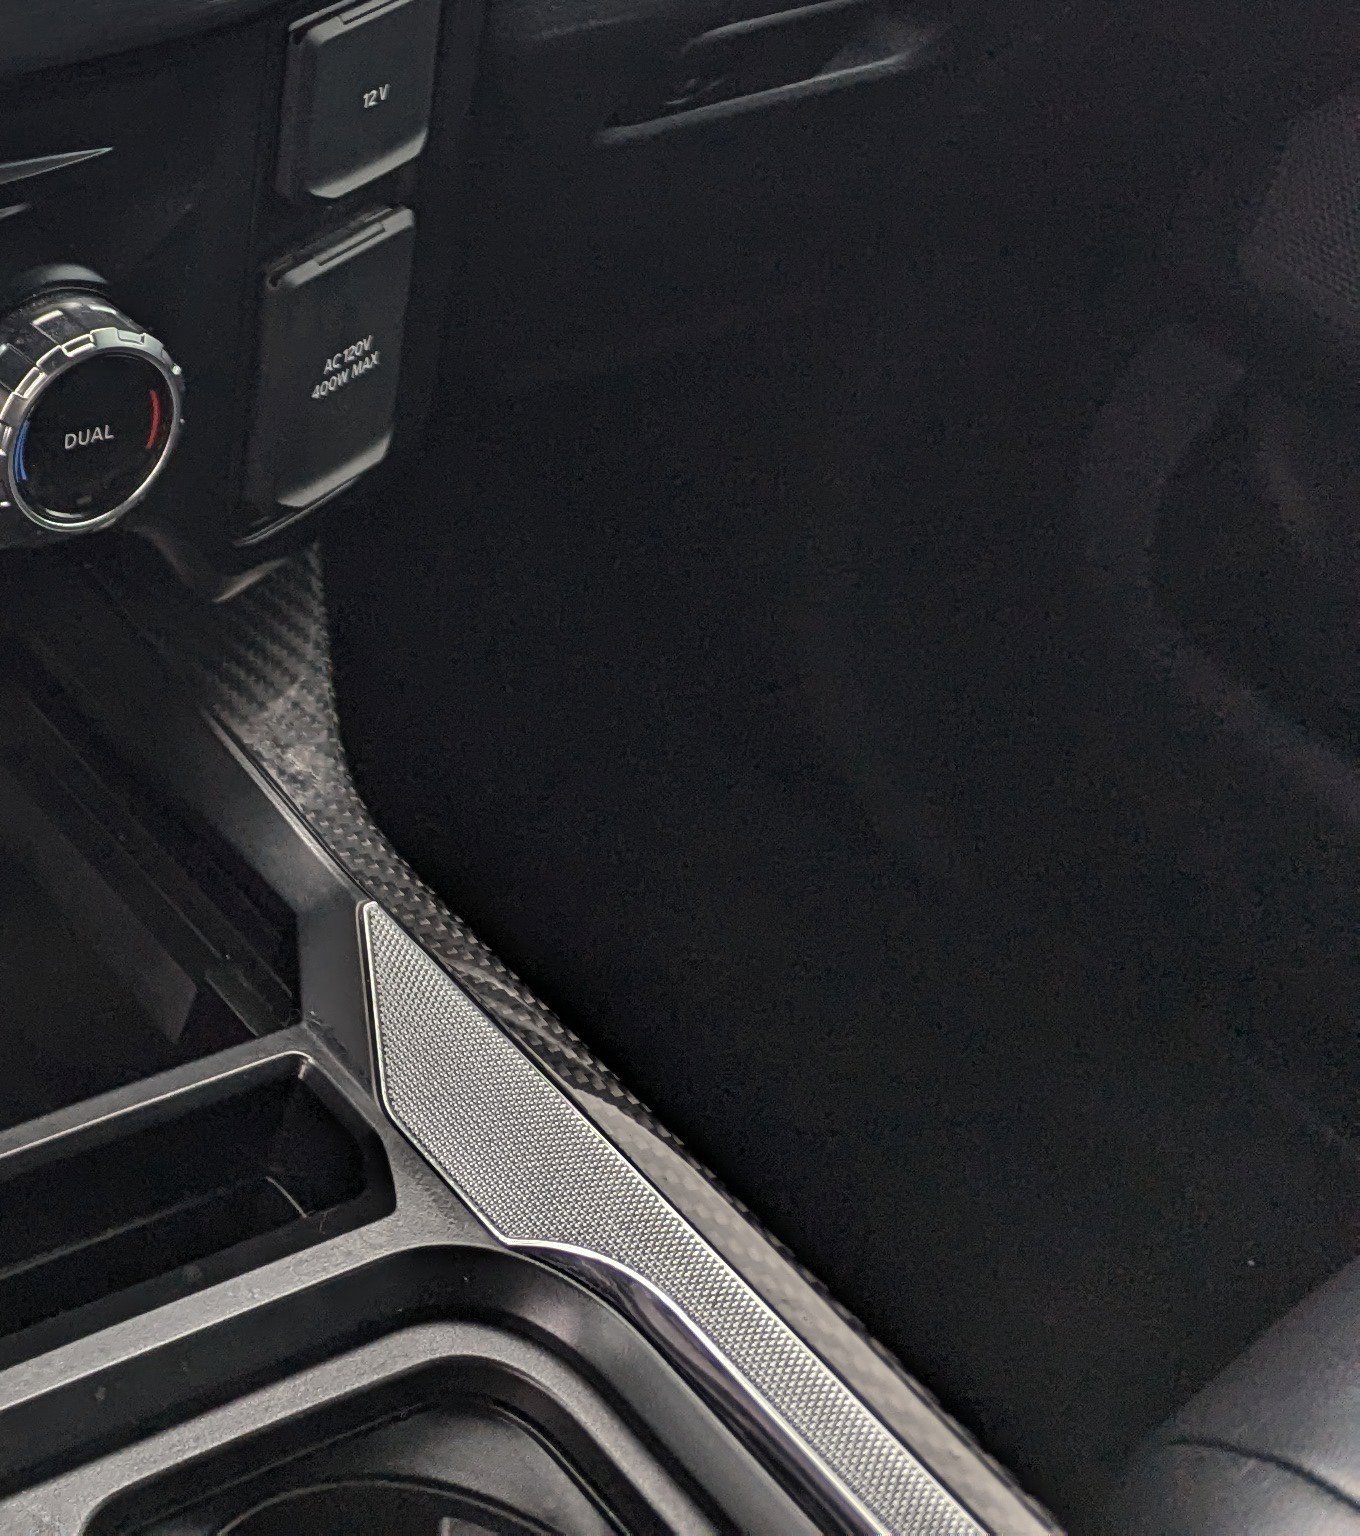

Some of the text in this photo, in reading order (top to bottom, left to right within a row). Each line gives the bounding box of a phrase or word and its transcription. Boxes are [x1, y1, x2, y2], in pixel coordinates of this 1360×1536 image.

[311, 351, 380, 400] 400W MAX
[323, 334, 373, 376] AC 120V
[63, 423, 115, 450] DUAL
